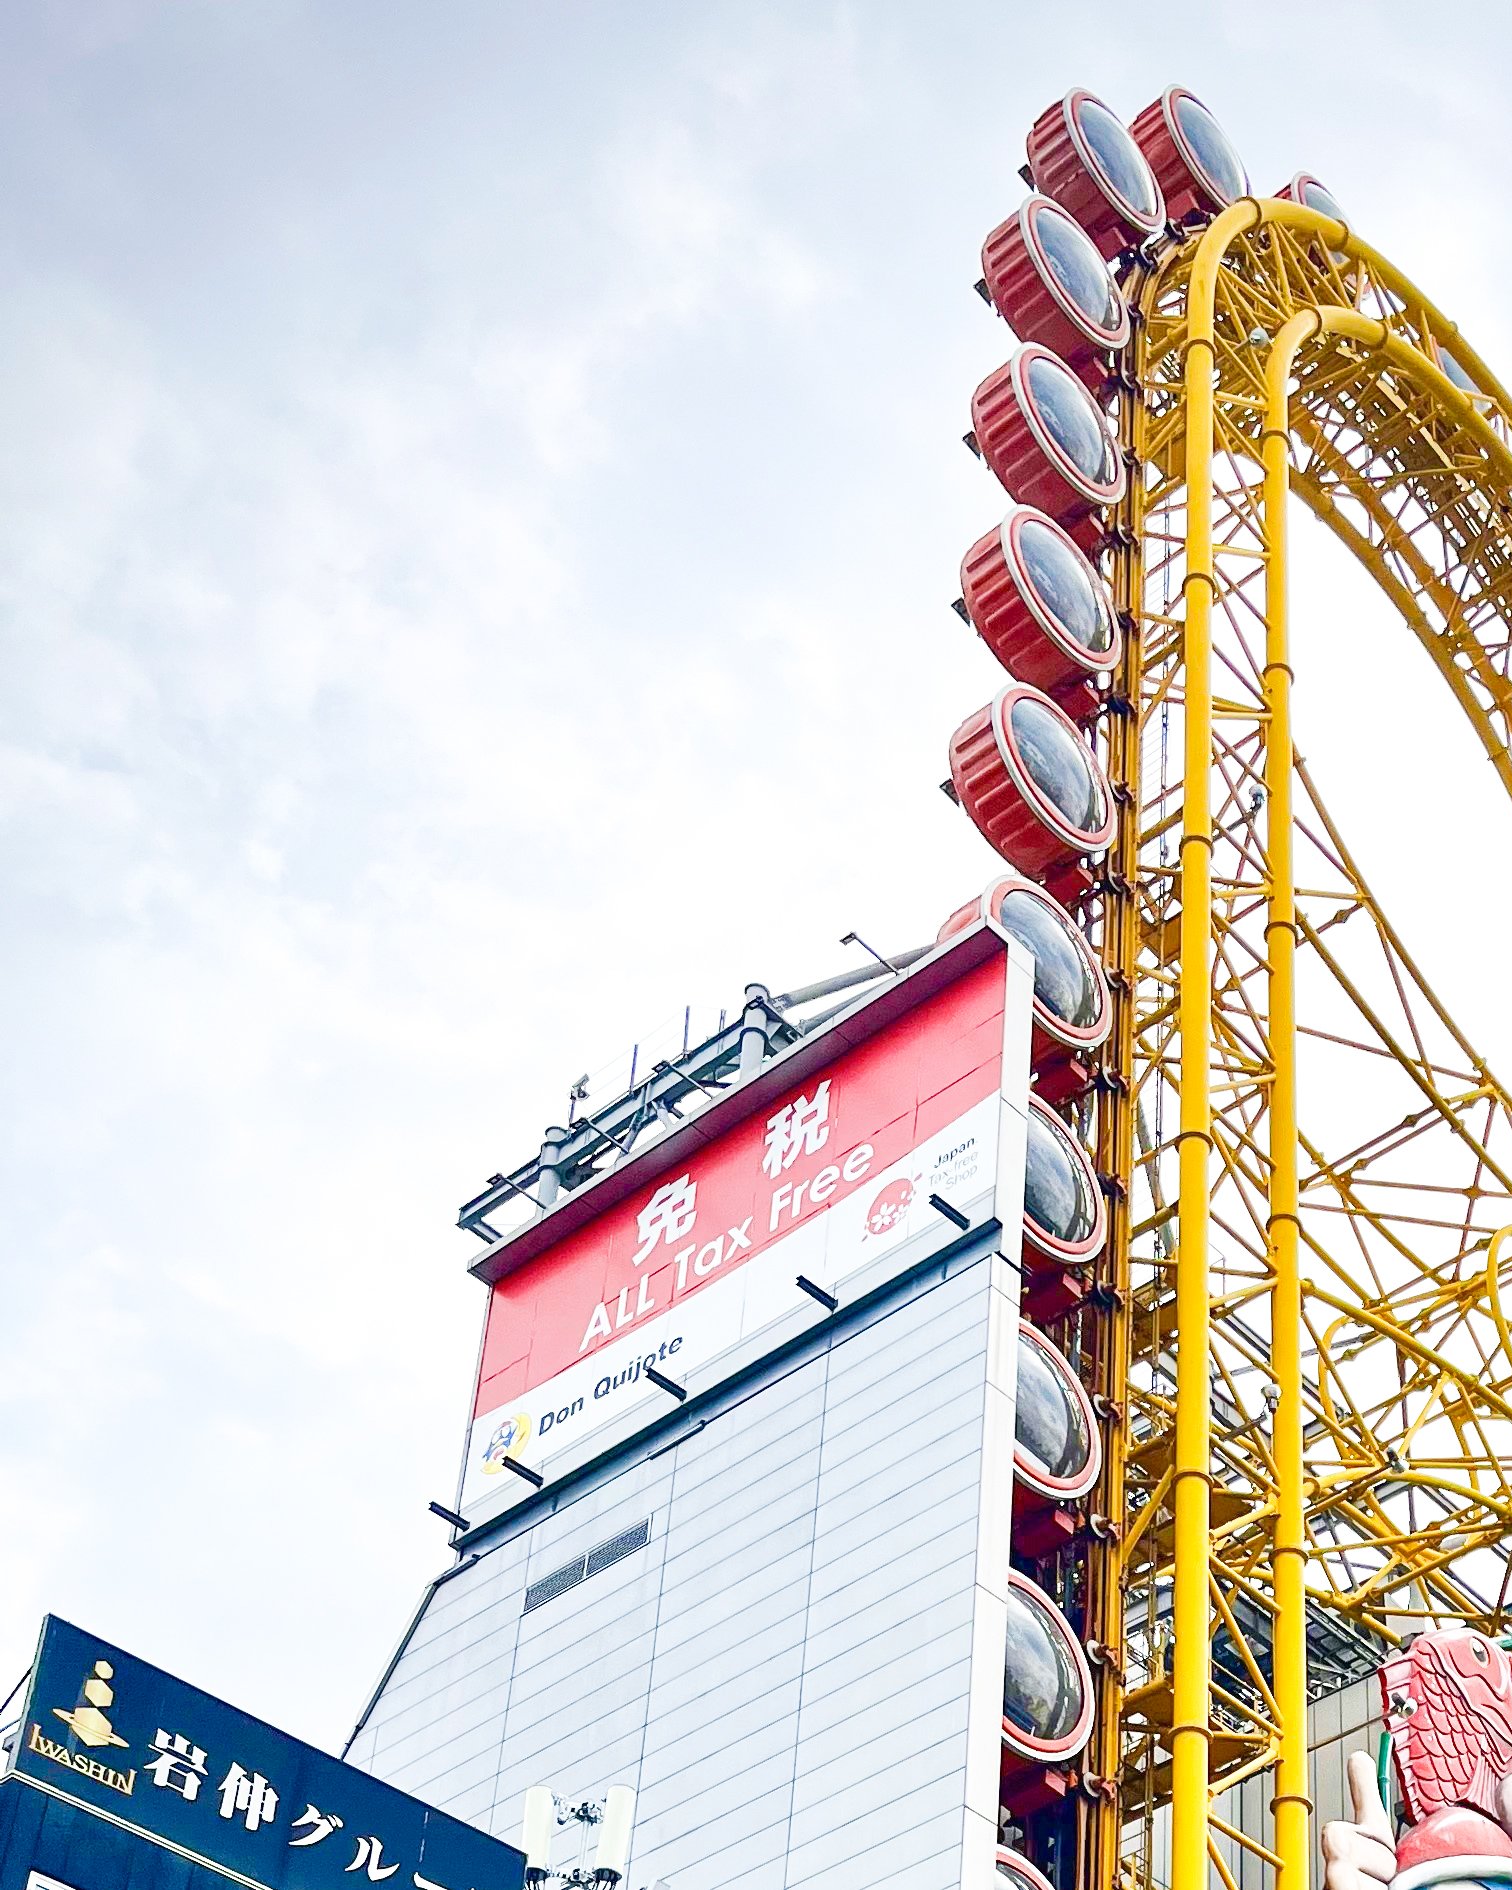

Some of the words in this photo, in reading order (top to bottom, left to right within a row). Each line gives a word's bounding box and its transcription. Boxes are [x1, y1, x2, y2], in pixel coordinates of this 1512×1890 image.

[632, 1079, 832, 1267] 免税
[945, 1165, 978, 1190] Shop
[578, 1273, 655, 1354] ALL
[674, 1216, 753, 1291] Tax
[769, 1144, 875, 1232] Free
[538, 1396, 584, 1436] Don
[594, 1336, 684, 1400] Quijote
[28, 1723, 138, 1796] IWASHIN
